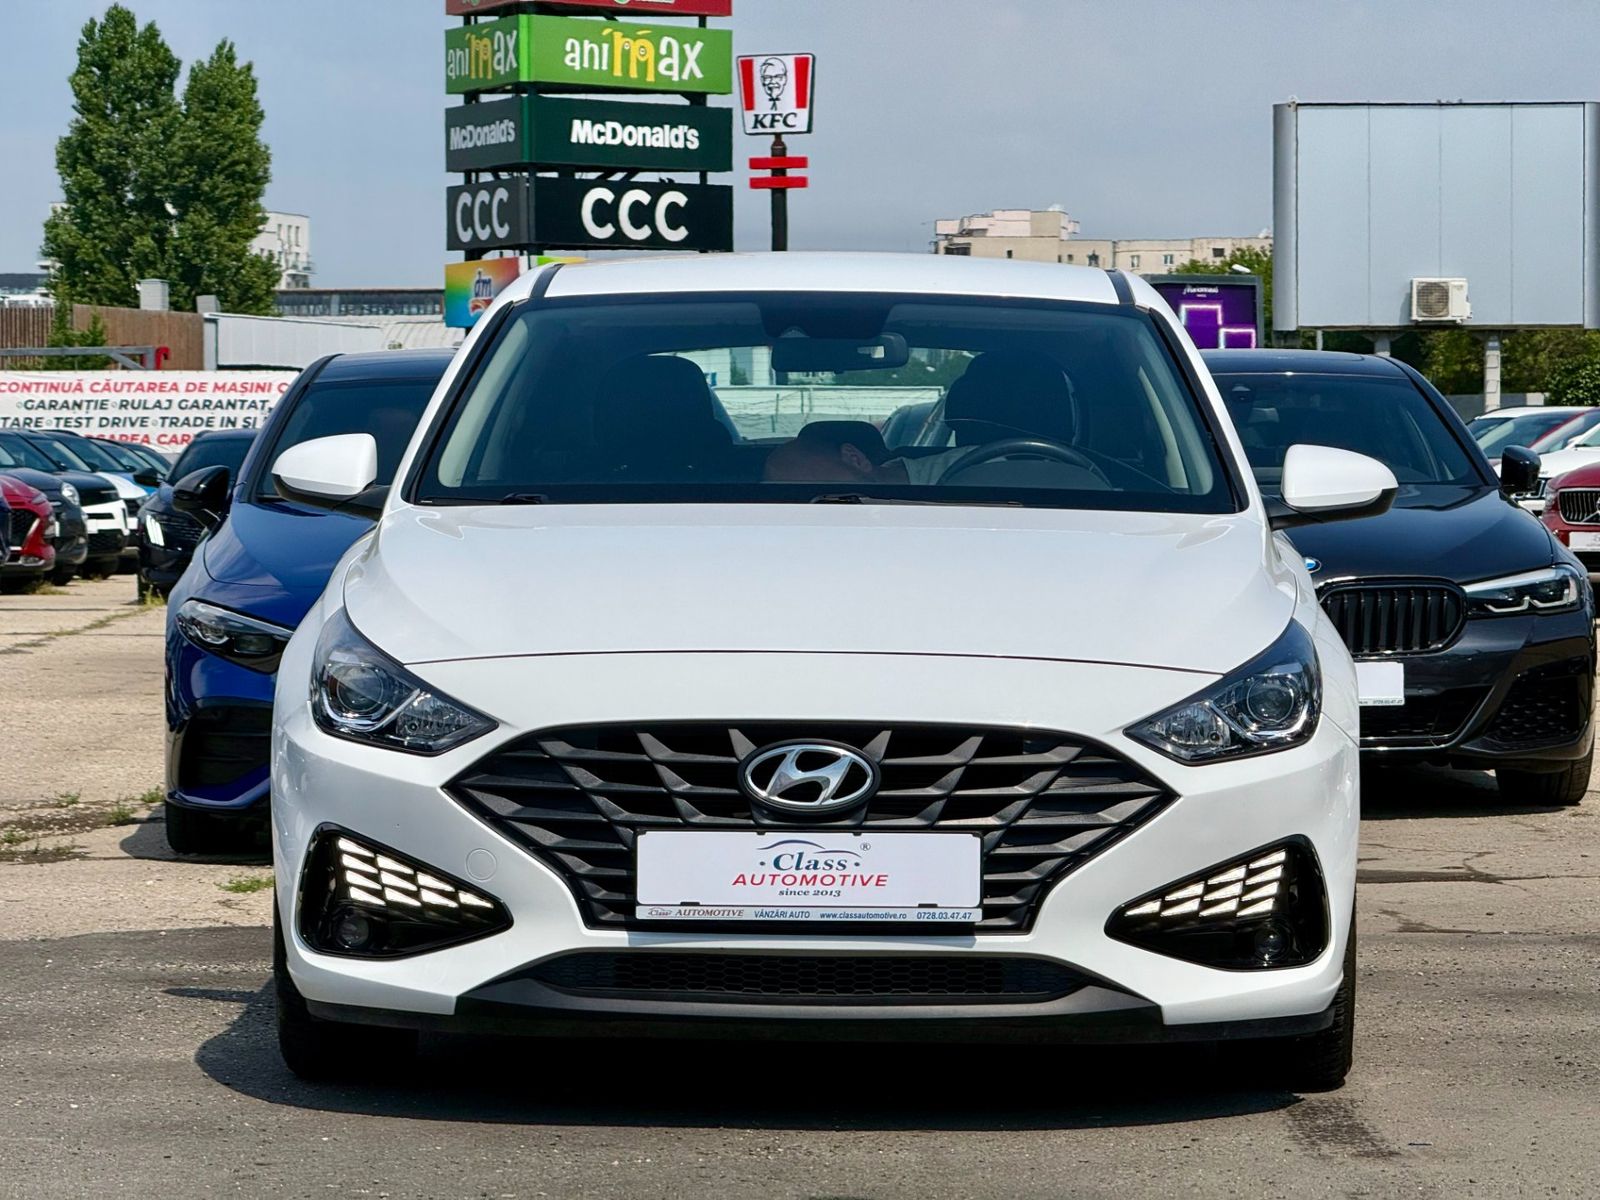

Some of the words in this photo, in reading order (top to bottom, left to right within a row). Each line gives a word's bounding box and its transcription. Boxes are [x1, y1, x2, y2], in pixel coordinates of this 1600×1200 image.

[447, 29, 518, 80] animax
[565, 28, 704, 83] animax
[752, 112, 797, 131] KFC
[449, 119, 516, 151] McDonald's
[571, 119, 700, 150] McDonald's
[455, 187, 510, 243] CCC
[581, 186, 690, 242] CCC
[474, 270, 492, 298] dm
[90, 379, 179, 393] CĂUTAREA
[185, 382, 209, 393] DE
[118, 399, 173, 411] RULAJ
[0, 416, 44, 428] TARE
[54, 416, 94, 428] TEST
[99, 416, 149, 428] DRIVE
[159, 416, 215, 428] TRADE
[220, 416, 237, 428] IN
[156, 433, 195, 445] CAR
[773, 851, 848, 871] Class
[732, 873, 889, 887] AUTOMOTIVE
[778, 888, 810, 896] since
[812, 889, 842, 898] 2013
[675, 908, 745, 917] AUTOMOTIVE
[789, 911, 811, 919] AUTO
[819, 911, 907, 920] www.classautomotive.ro
[916, 911, 972, 920] 0728.03.47.47
